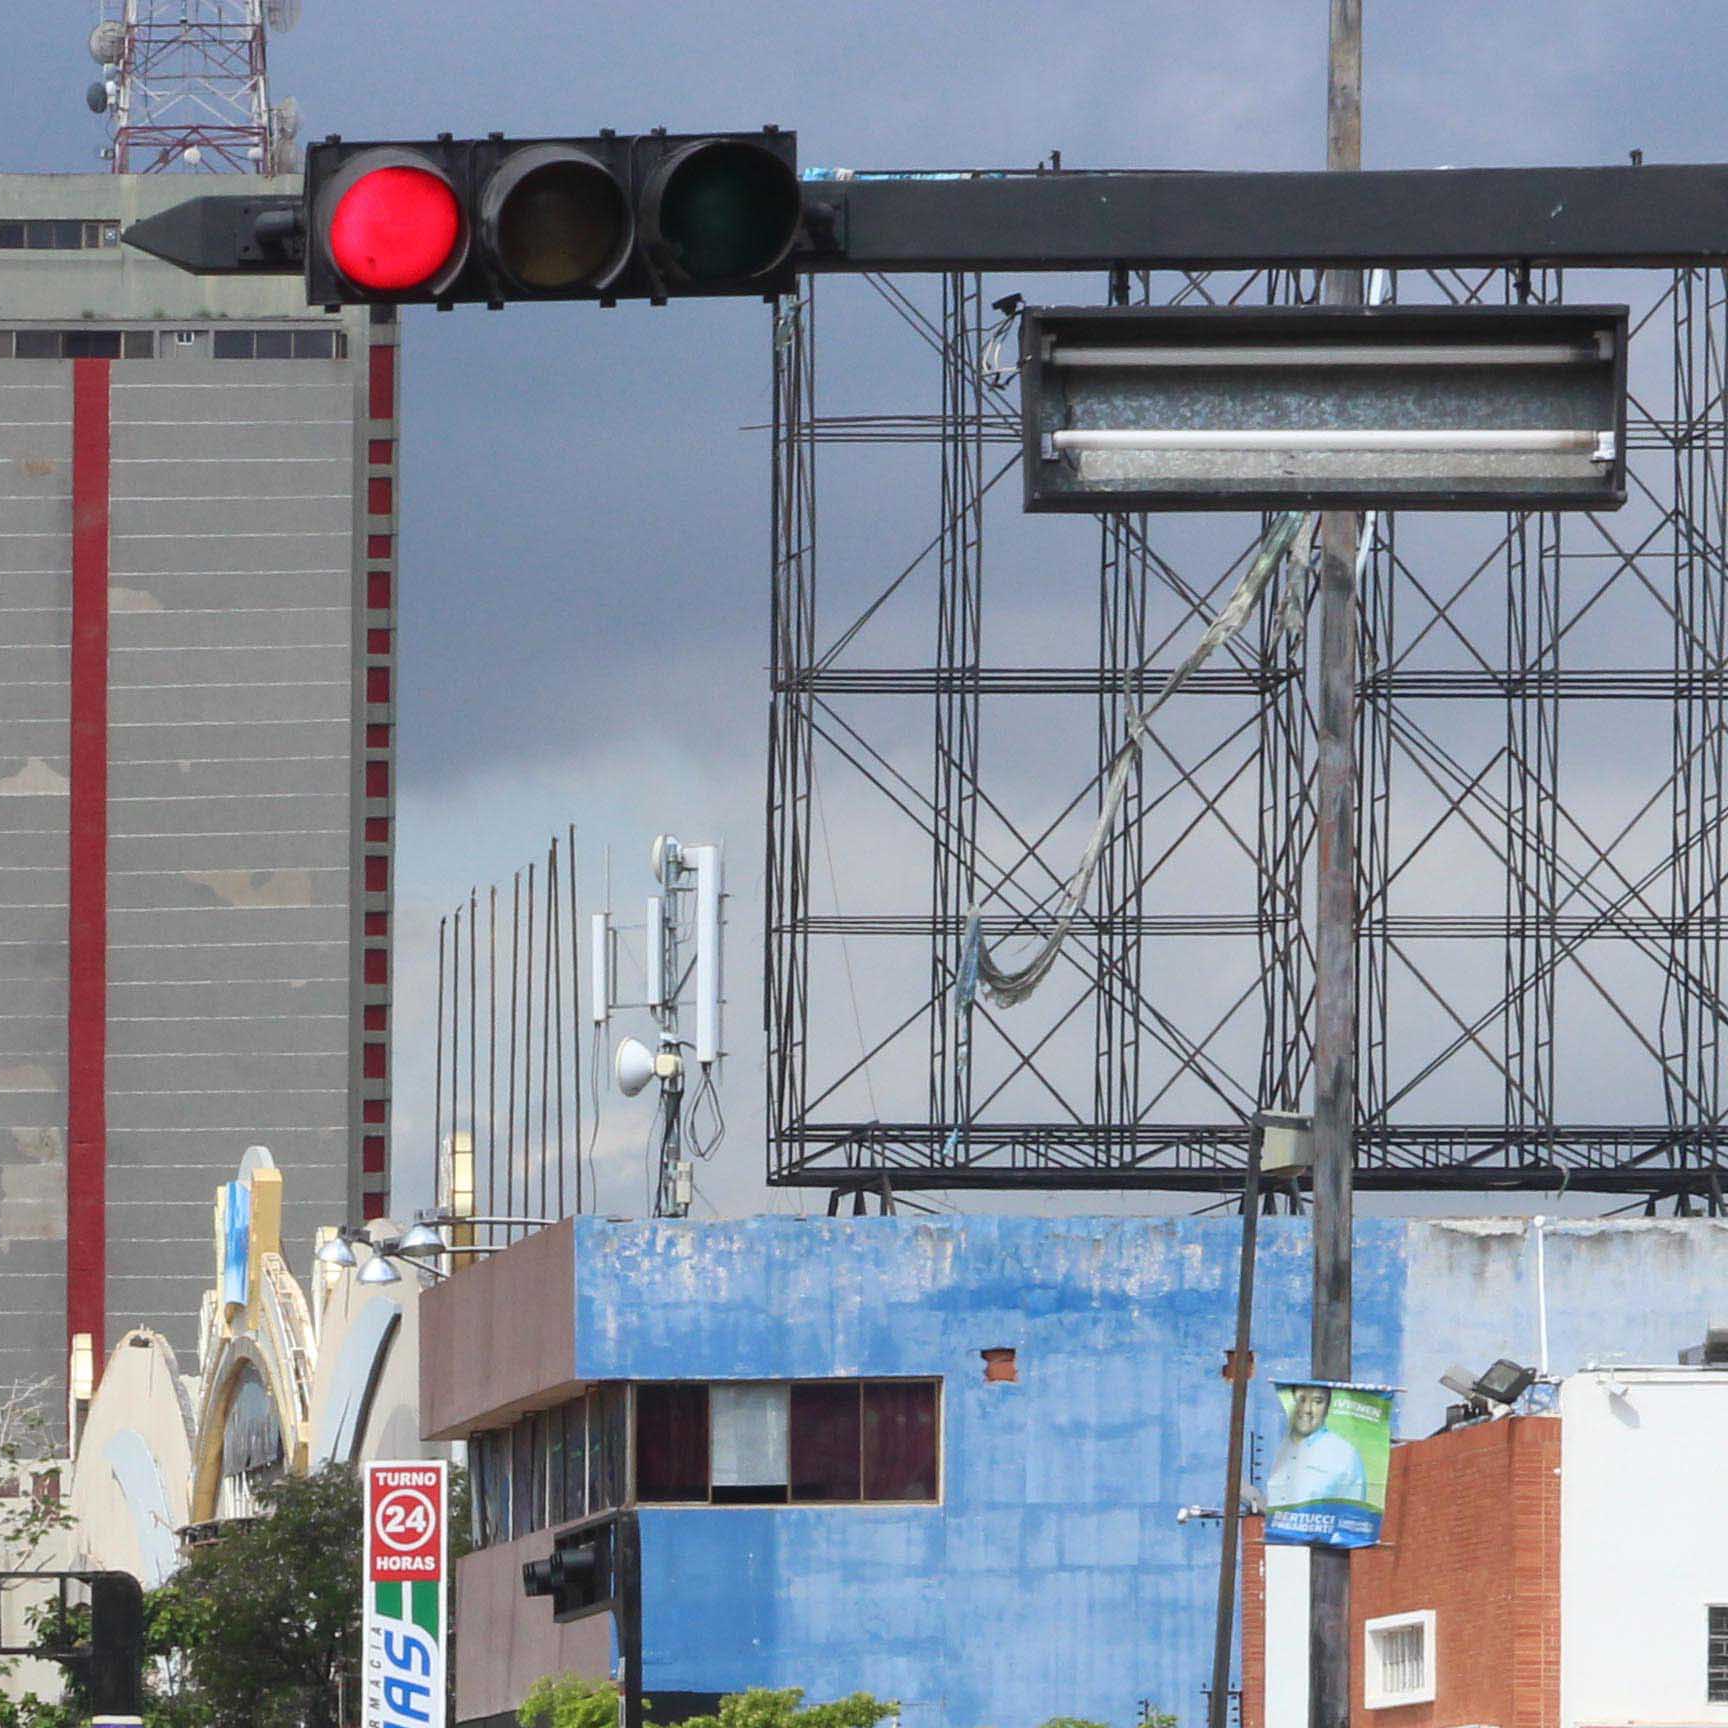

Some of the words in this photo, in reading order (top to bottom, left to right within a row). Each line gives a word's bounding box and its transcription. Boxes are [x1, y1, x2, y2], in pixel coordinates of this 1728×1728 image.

[375, 1472, 437, 1487] TURNO
[384, 1505, 427, 1533] 24
[375, 1556, 435, 1571] HORAS
